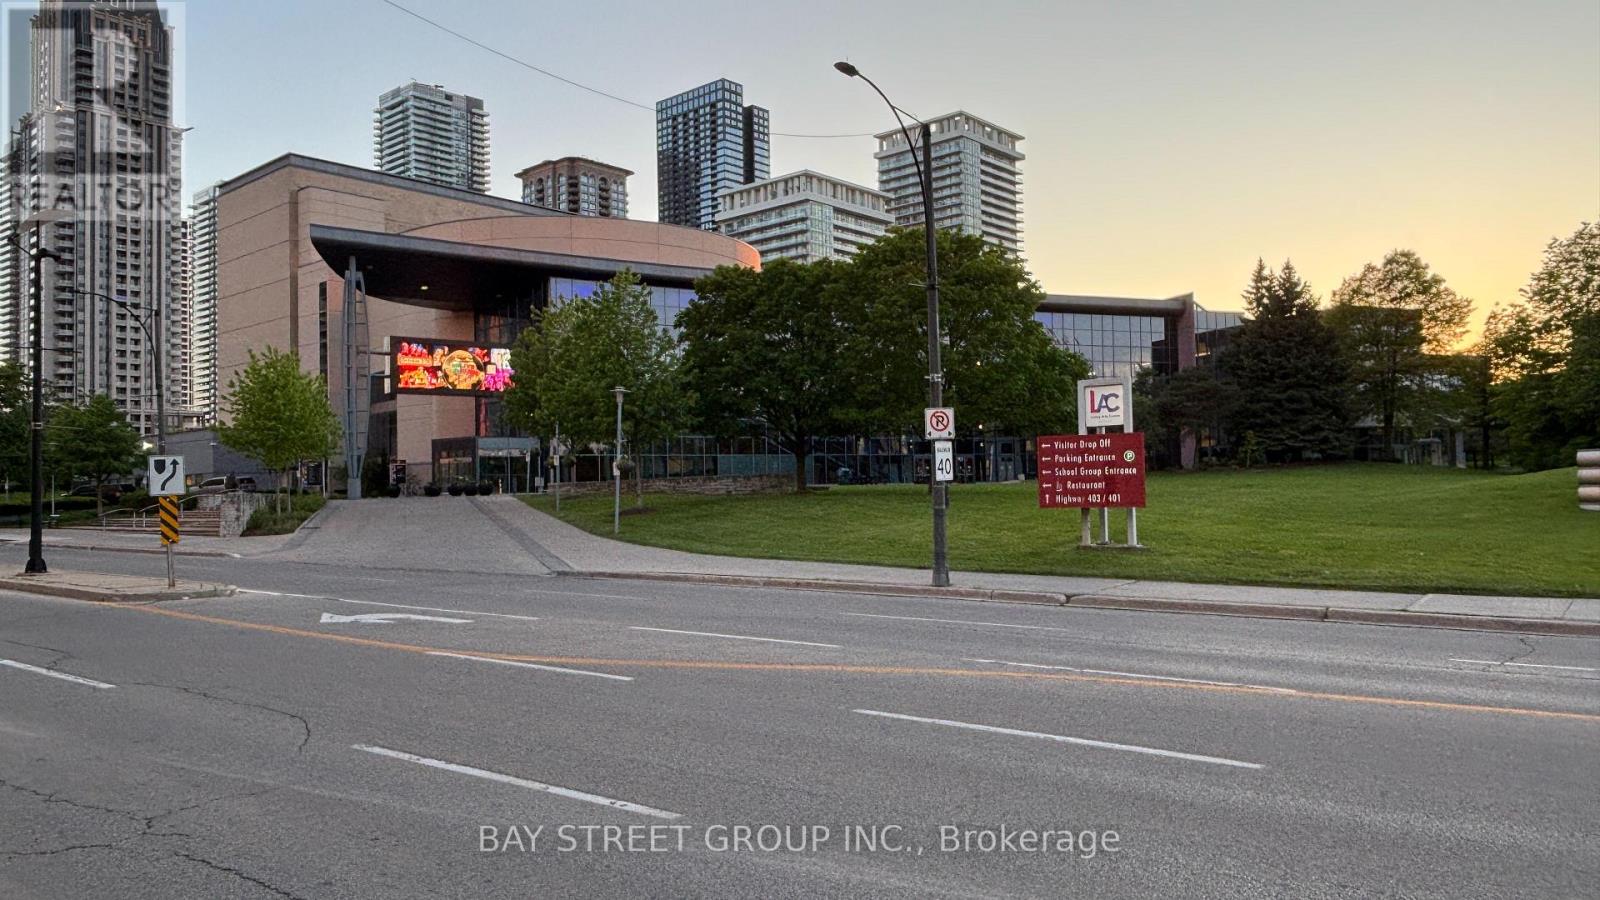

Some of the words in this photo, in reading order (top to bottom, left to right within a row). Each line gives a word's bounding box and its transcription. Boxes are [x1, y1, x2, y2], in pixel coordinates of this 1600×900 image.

[1090, 390, 1120, 413] LAC
[1054, 441, 1077, 449] Visitor
[1079, 440, 1097, 449] Drop
[1099, 439, 1111, 448] Off
[1054, 454, 1082, 463] Parking
[1084, 453, 1116, 462] Entrance
[937, 458, 952, 474] 40
[1055, 467, 1078, 476] School
[1080, 467, 1102, 476] Group
[1104, 466, 1137, 475] Entrance
[1066, 481, 1106, 489] Restaurant
[1087, 494, 1101, 503] 403
[1107, 493, 1121, 502] 401
